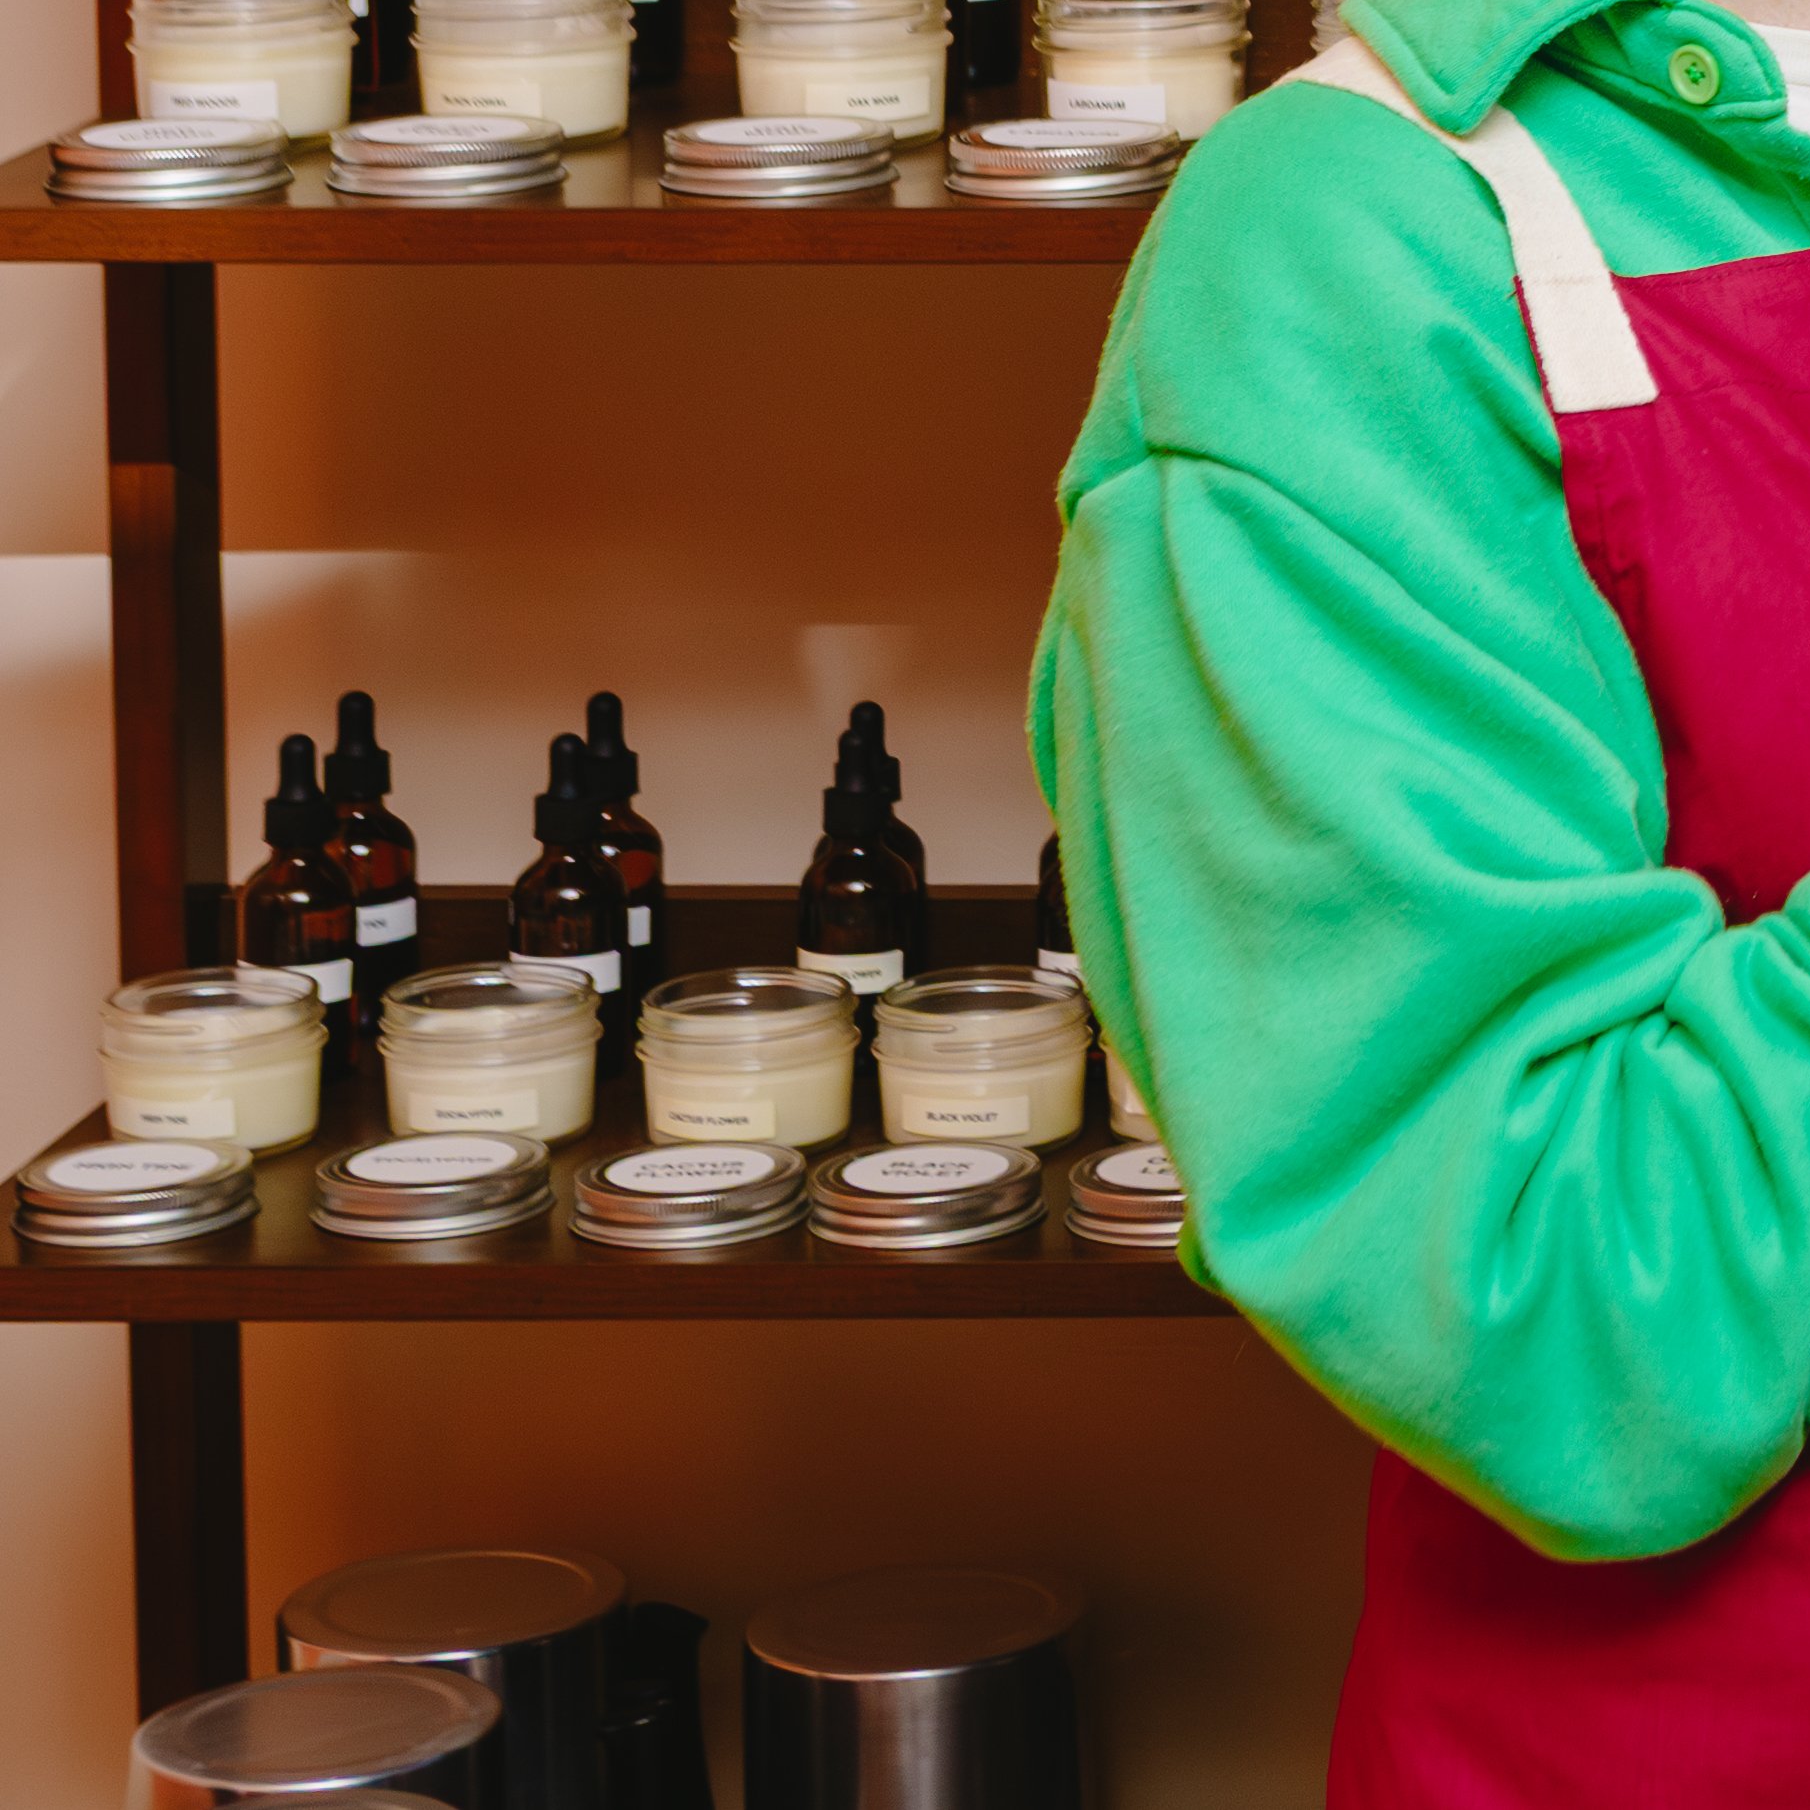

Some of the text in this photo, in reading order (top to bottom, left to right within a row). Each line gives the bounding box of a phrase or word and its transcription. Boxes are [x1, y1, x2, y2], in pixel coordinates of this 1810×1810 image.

[926, 1111, 999, 1124] BLACK VIOLET
[640, 1160, 746, 1171] CACTUS
[889, 1160, 975, 1170] BLACK
[633, 1169, 743, 1179] FLOWER
[880, 1169, 966, 1178] VIOLET
